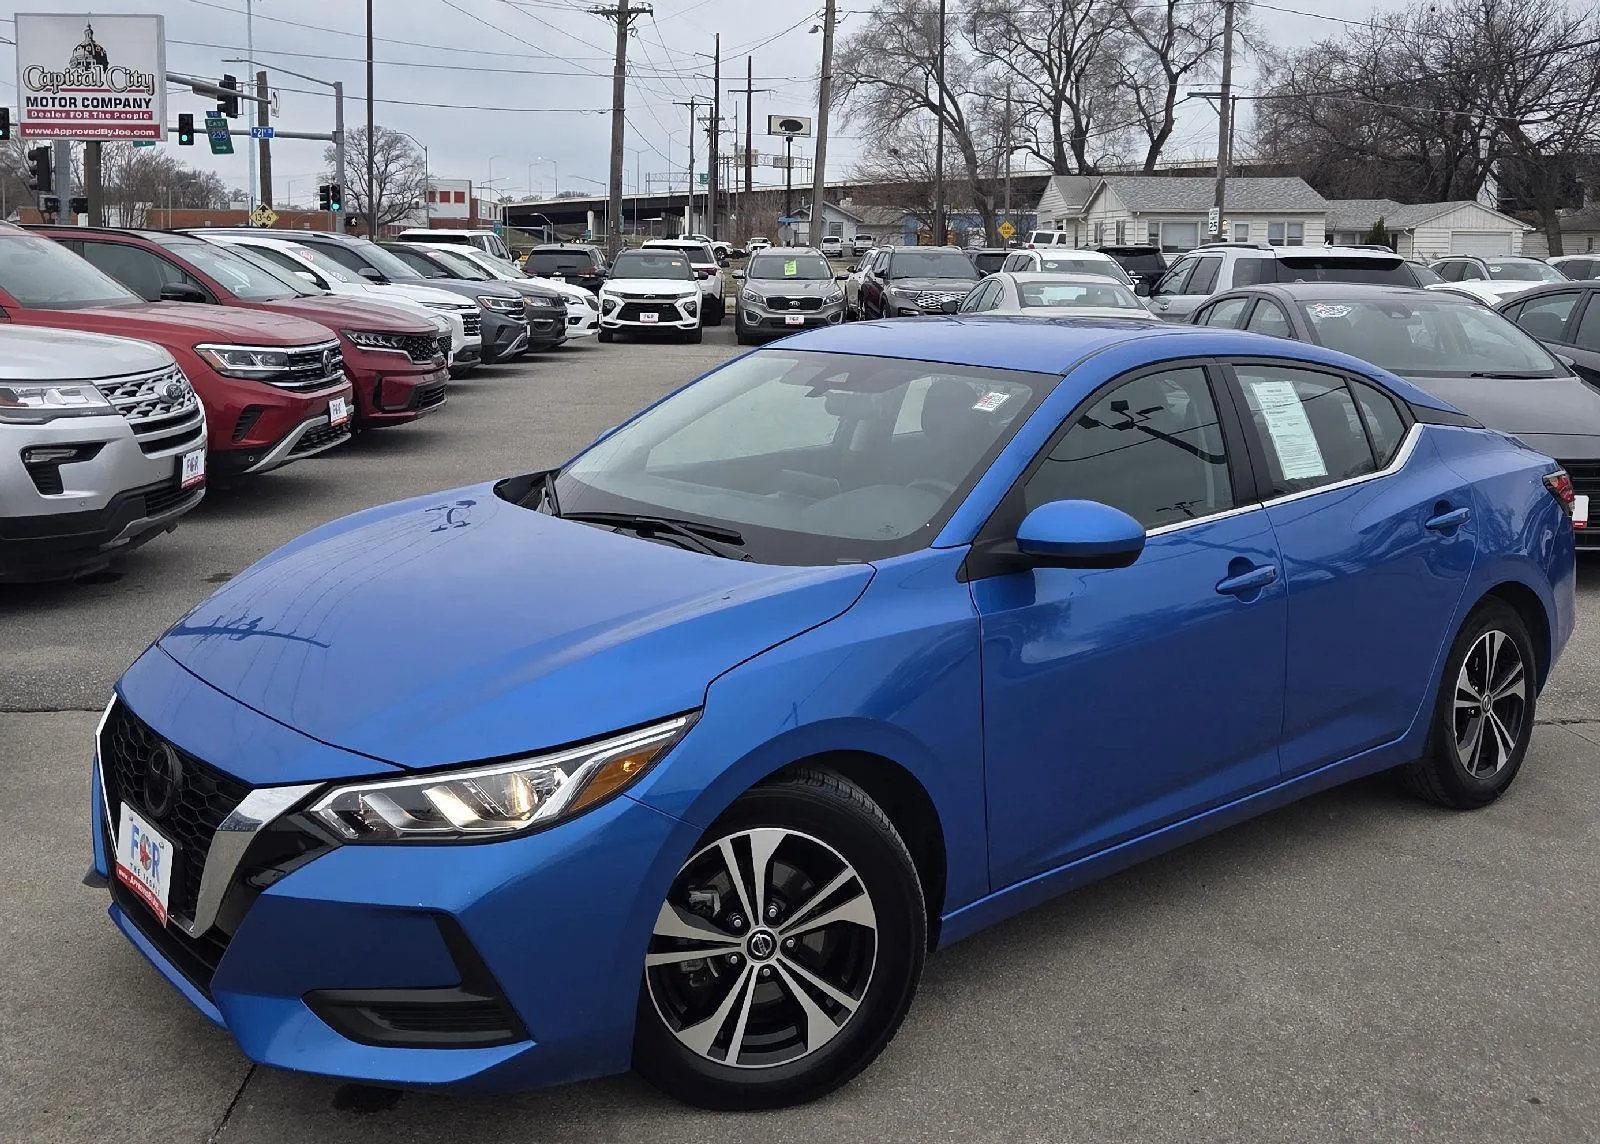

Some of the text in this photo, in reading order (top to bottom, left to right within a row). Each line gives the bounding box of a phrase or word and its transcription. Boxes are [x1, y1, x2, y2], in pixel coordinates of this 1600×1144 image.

[23, 65, 155, 96] Capital City
[26, 96, 152, 109] MOTOR COMPANY
[31, 110, 67, 119] Dealer
[70, 111, 89, 119] FOR
[93, 112, 112, 120] The
[25, 127, 156, 138] www.ApprovedByJoe.com
[211, 131, 227, 139] 235
[1209, 221, 1218, 232] 25
